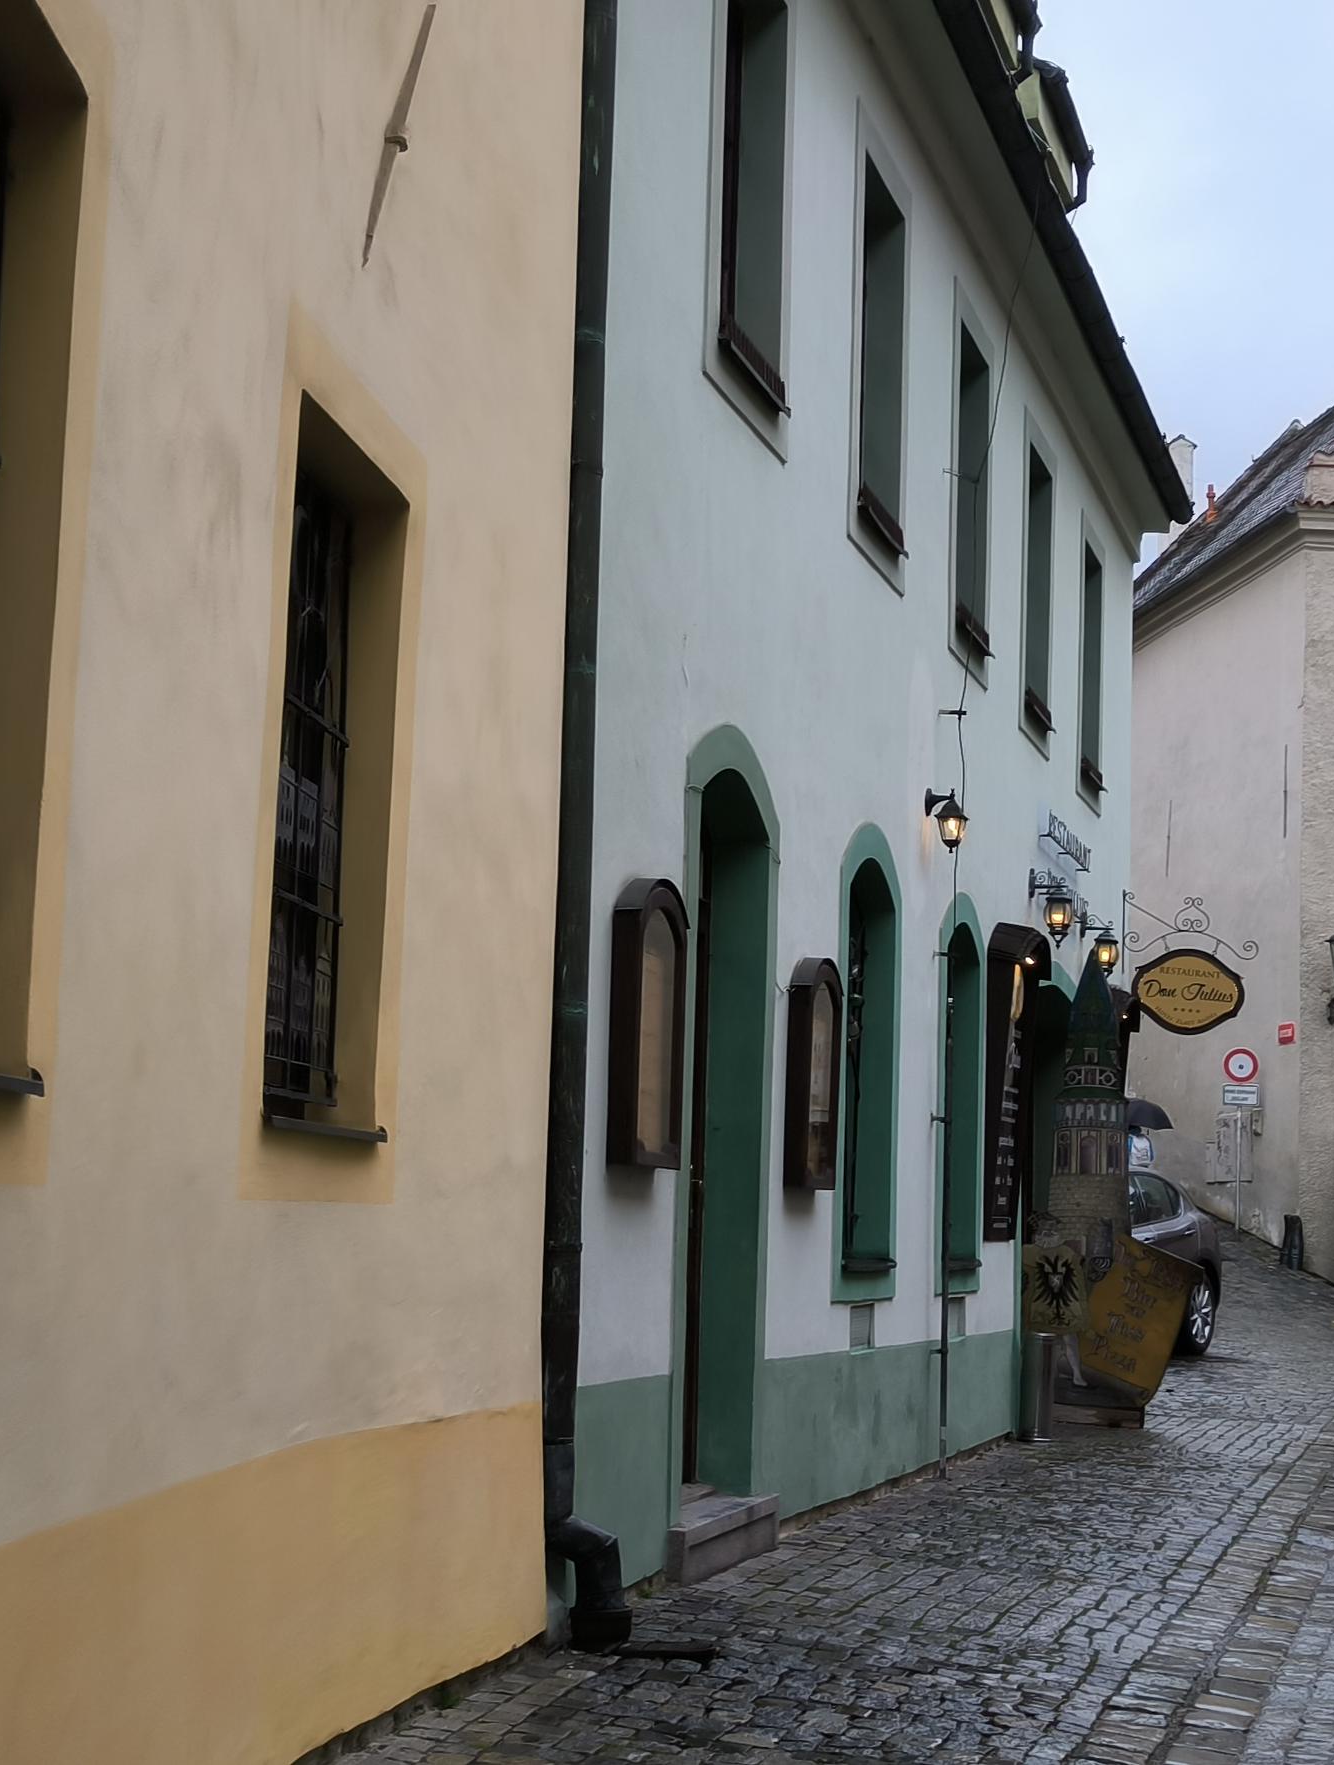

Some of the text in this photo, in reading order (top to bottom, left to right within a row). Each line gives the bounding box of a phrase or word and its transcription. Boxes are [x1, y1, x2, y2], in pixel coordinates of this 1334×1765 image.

[1048, 809, 1092, 871] RESTAURANT
[1159, 966, 1220, 979] RESTAURANT
[1143, 979, 1234, 1003] Don Julius
